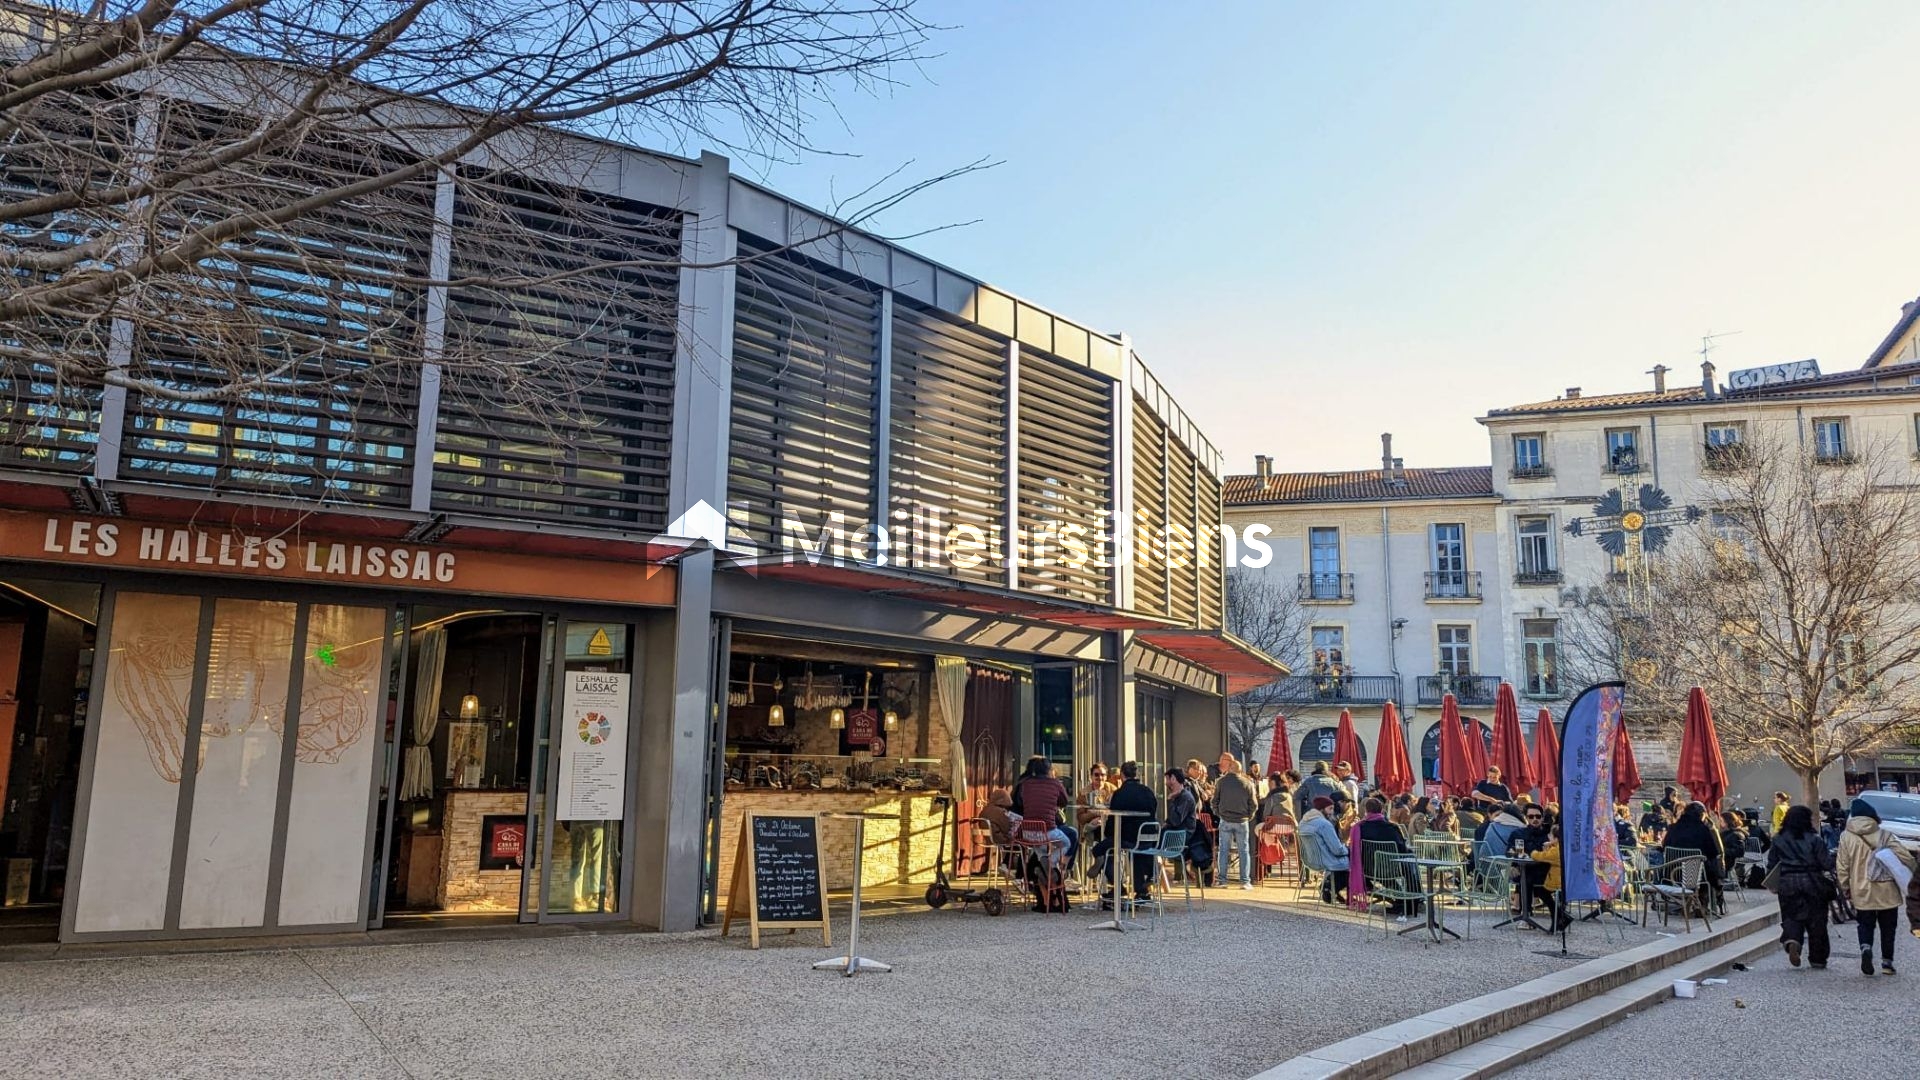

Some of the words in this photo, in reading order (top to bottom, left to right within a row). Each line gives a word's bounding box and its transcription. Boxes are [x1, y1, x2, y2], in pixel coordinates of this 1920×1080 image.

[43, 518, 118, 557] LES
[139, 527, 288, 570] HALLES
[305, 541, 456, 583] LAISSAC
[575, 683, 618, 693] LAISSAC
